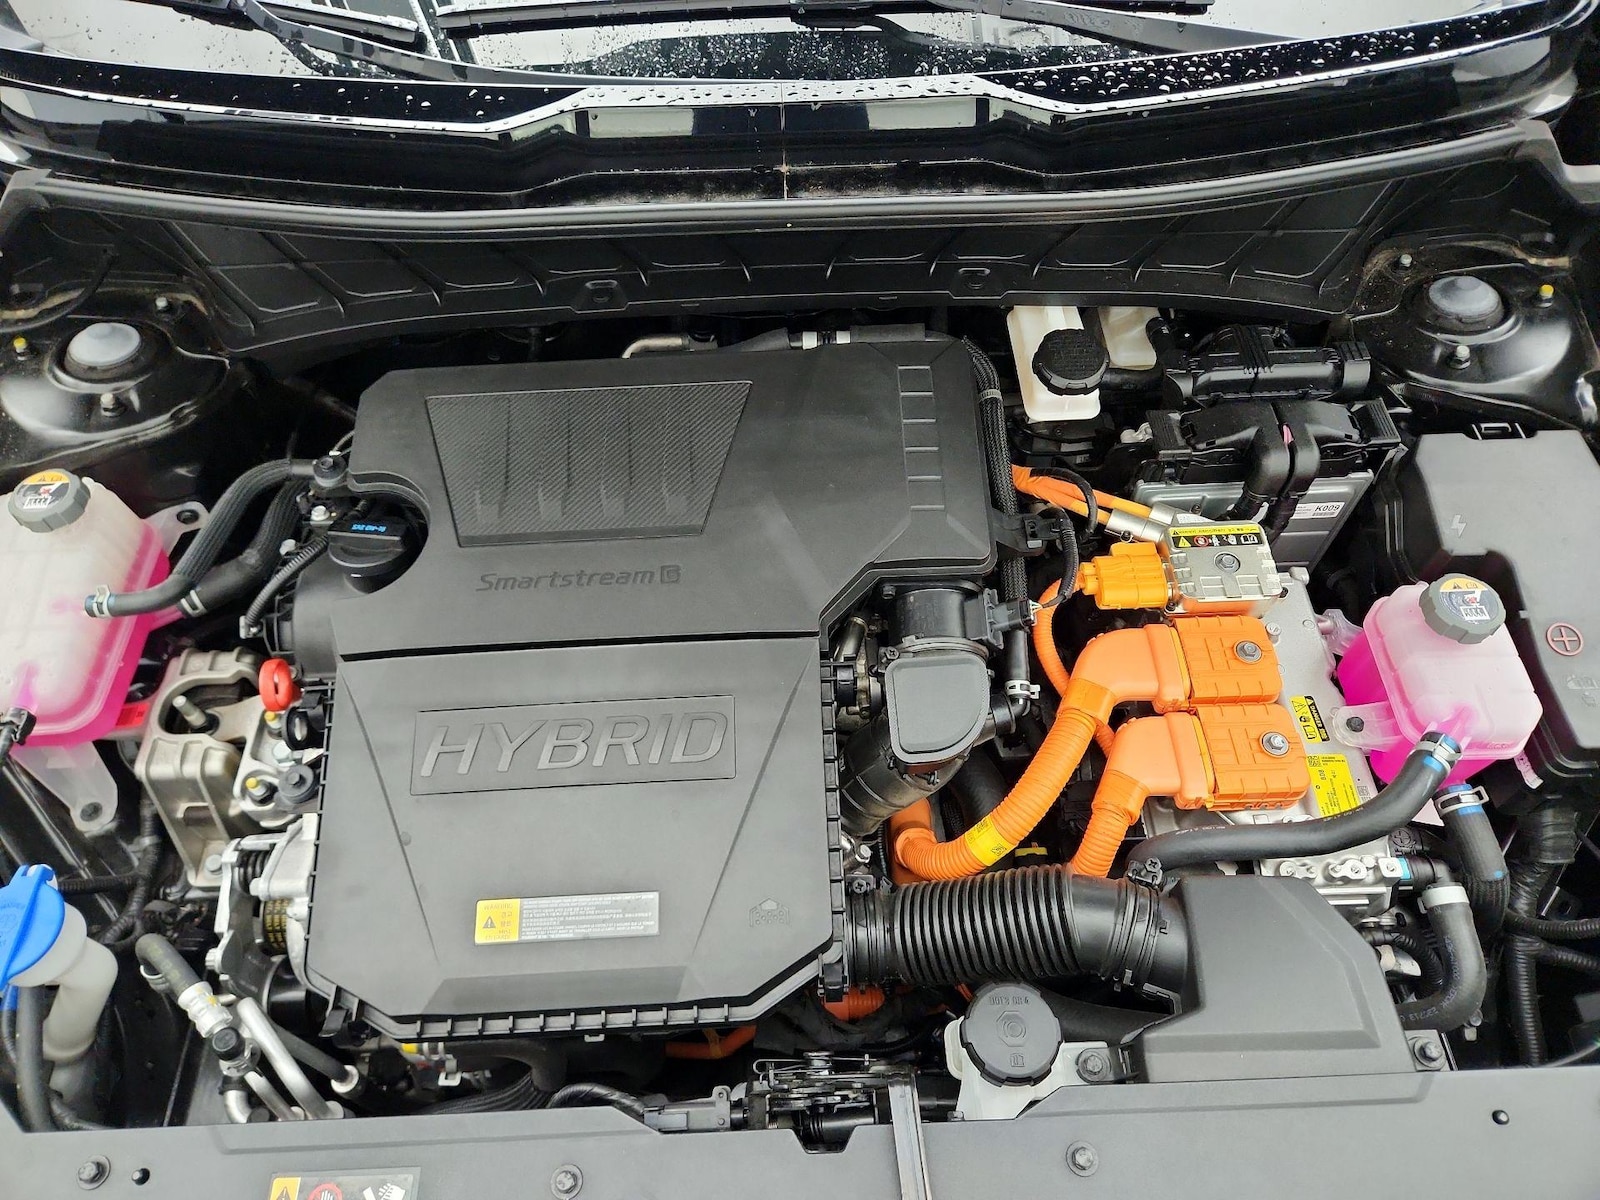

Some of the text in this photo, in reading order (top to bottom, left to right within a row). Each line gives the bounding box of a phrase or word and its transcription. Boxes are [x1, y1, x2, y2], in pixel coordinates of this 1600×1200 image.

[1314, 504, 1341, 512] K009
[476, 569, 655, 592] Smartstream
[1309, 705, 1323, 729] DANGER
[420, 711, 728, 778] HYBRID
